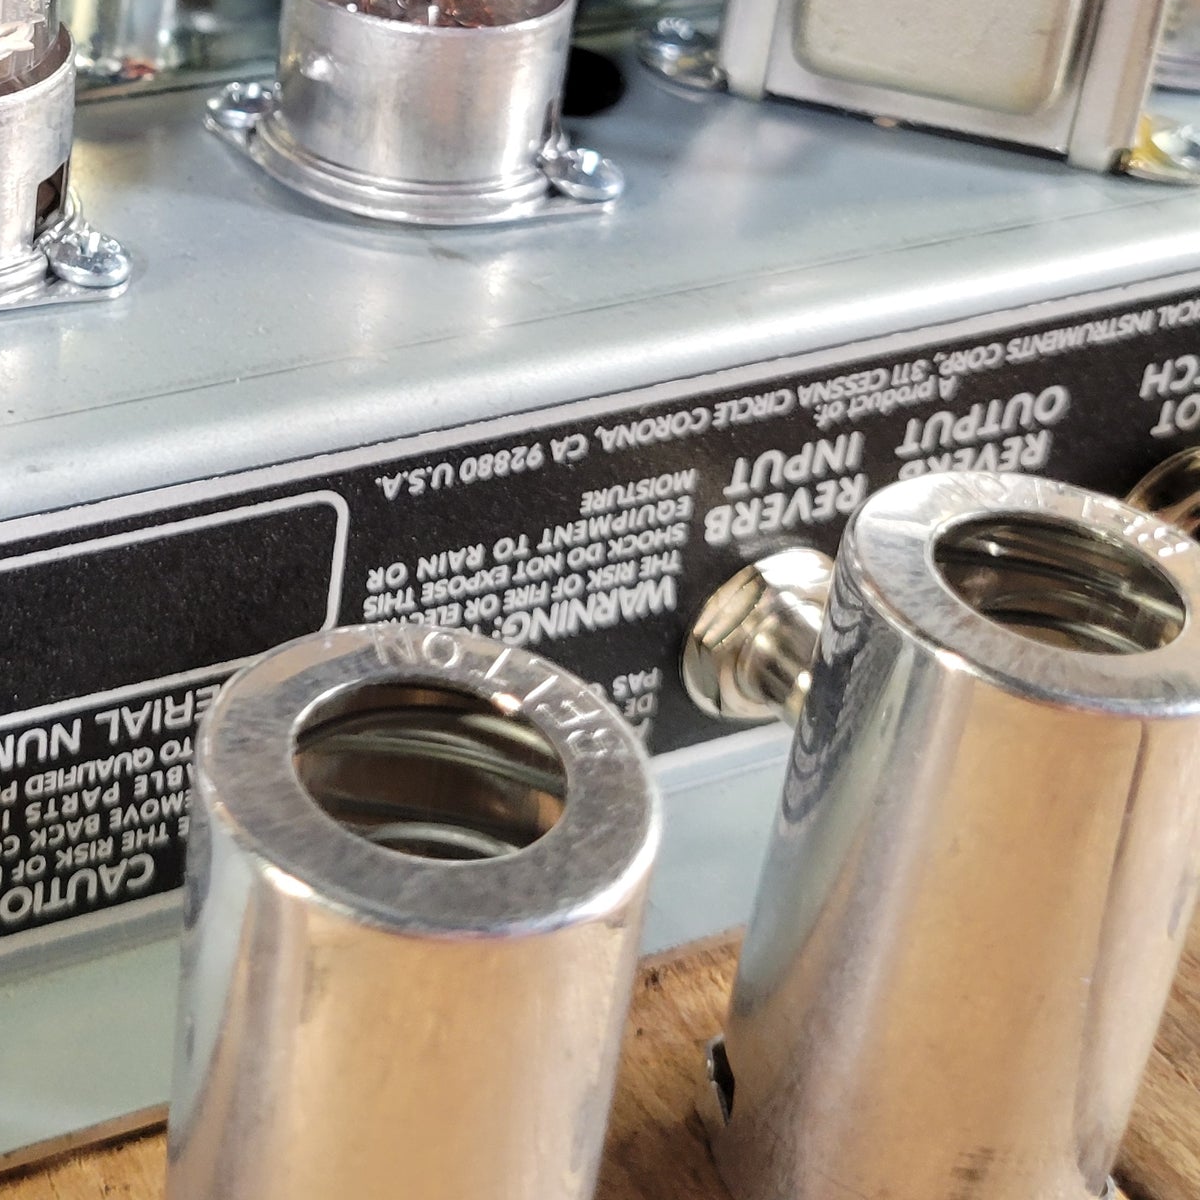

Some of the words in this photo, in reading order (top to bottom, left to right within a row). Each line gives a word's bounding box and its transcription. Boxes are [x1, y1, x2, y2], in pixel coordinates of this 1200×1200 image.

[1157, 299, 1200, 328] ICAL
[1005, 309, 1156, 364] INSTRUMENTS
[797, 368, 890, 410] CESSNA
[891, 359, 929, 387] 311
[939, 375, 957, 400] A
[712, 388, 796, 431] CIRCLE
[847, 374, 939, 421] product
[1150, 393, 1200, 439] OT
[595, 407, 712, 454] CORONA,
[895, 385, 1071, 459] OUTPUT
[459, 443, 544, 484] 92880
[550, 433, 589, 464] CA
[723, 431, 865, 499] INPUT
[375, 462, 455, 501] U.S.A.
[580, 468, 697, 516] MOISTURE
[537, 495, 693, 554] EQUIPMENT
[704, 473, 868, 546] REVERB
[493, 534, 530, 563] TO
[567, 542, 606, 571] DO
[607, 522, 688, 562] SHOCK
[366, 562, 408, 594] OR
[417, 543, 485, 582] RAIN
[512, 552, 565, 585] NOT
[586, 560, 638, 592] RISK
[639, 550, 682, 580] THE
[363, 587, 418, 621] THIS
[421, 565, 511, 607] EXPOSE
[503, 581, 548, 613] FIRE
[551, 573, 585, 601] OF
[464, 594, 500, 623] OR
[492, 575, 677, 645] WARNING:
[612, 667, 661, 699] PAS
[95, 683, 222, 746] ERIAL
[159, 737, 193, 765] TO
[24, 746, 154, 799] QUALIFIED
[25, 781, 119, 826] PARTS
[109, 789, 192, 829] EMOVE
[30, 813, 99, 849] BACK
[122, 822, 169, 852] THE
[11, 855, 46, 881] OF
[55, 836, 113, 870] RISK
